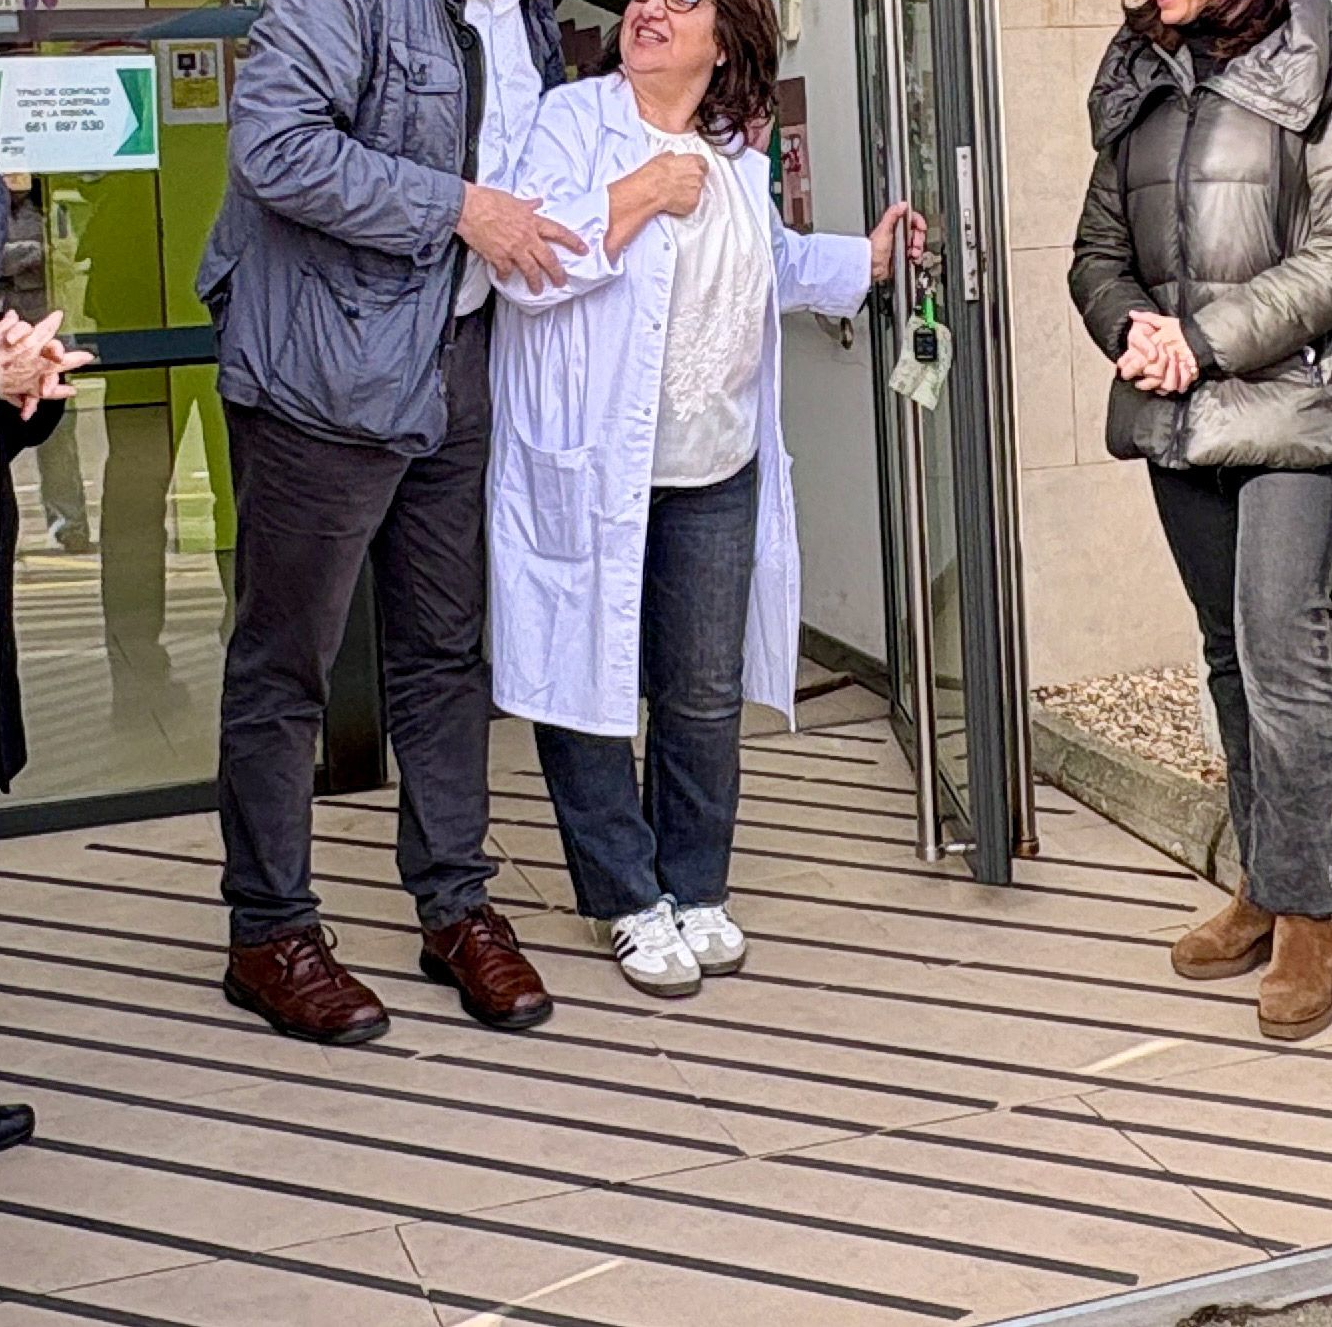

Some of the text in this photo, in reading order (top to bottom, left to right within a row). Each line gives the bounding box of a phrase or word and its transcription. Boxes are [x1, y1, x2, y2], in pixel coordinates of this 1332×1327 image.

[44, 88, 57, 96] DE
[59, 87, 111, 96] CONTACTO
[17, 98, 111, 108] CENTRO CASTRILLO
[31, 109, 44, 118] DE
[46, 109, 59, 118] LA
